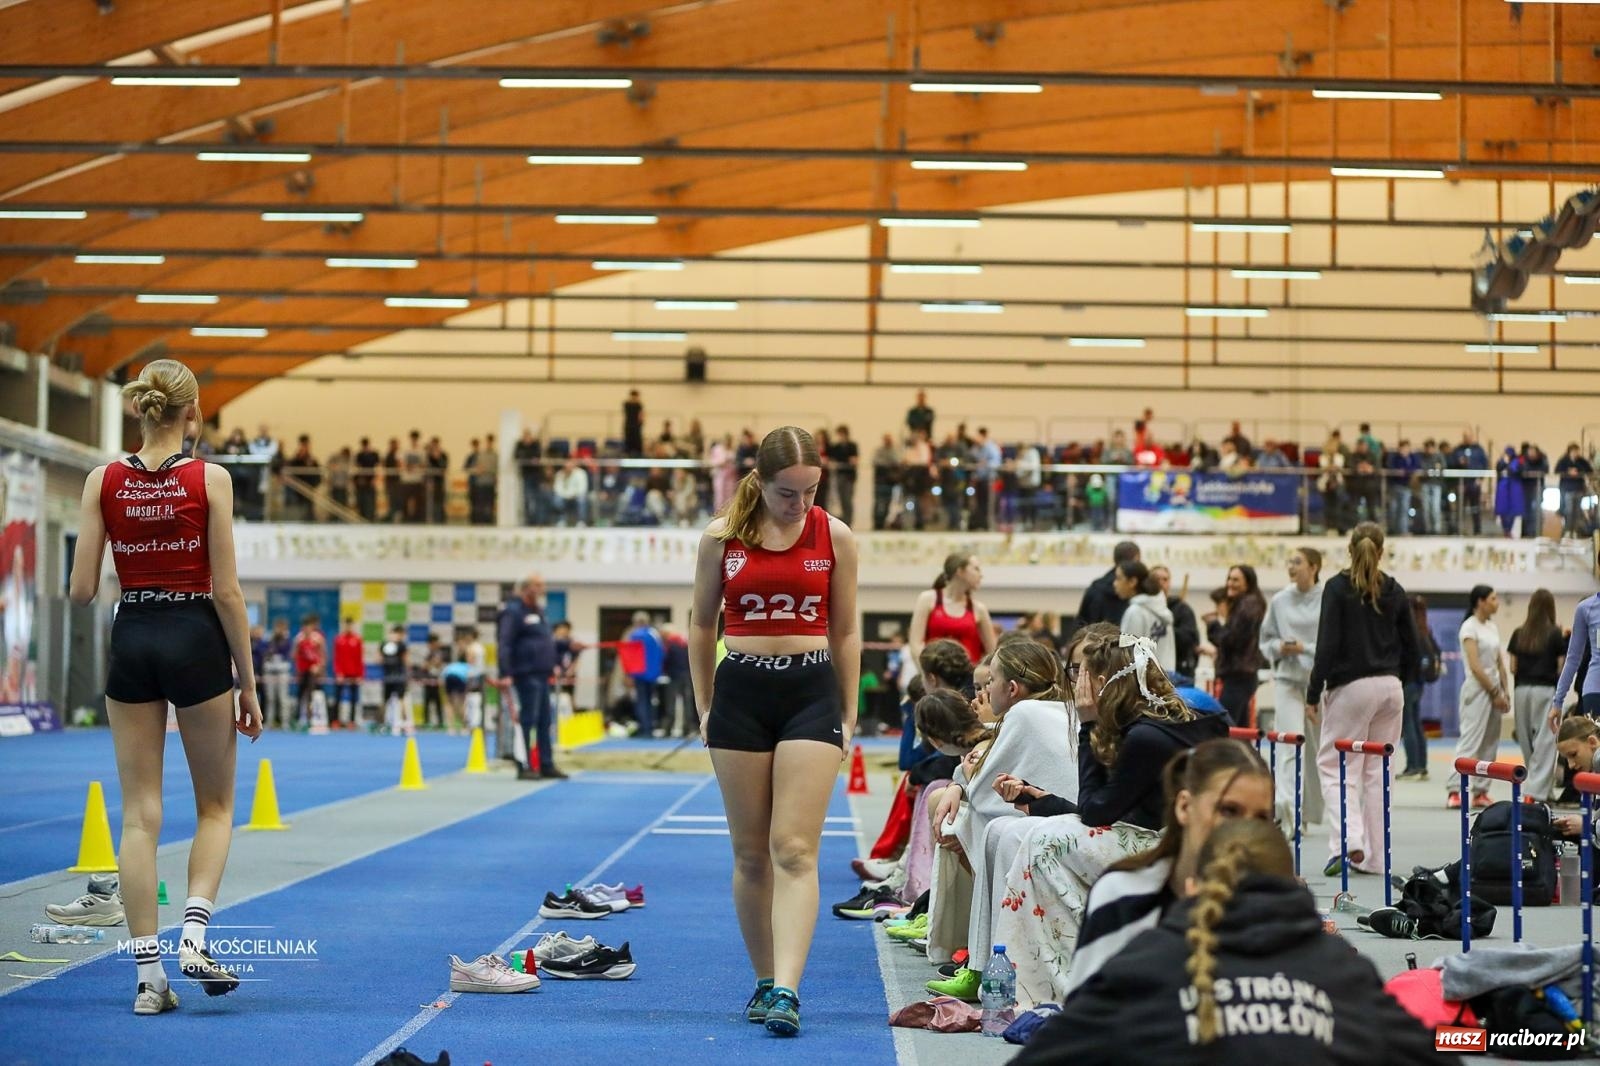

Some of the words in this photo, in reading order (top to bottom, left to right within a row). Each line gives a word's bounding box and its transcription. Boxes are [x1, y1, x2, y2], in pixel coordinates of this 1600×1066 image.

[113, 535, 201, 556] allsport.net.pl
[740, 593, 822, 622] 225
[740, 655, 792, 670] PRO
[1178, 978, 1234, 1012] US
